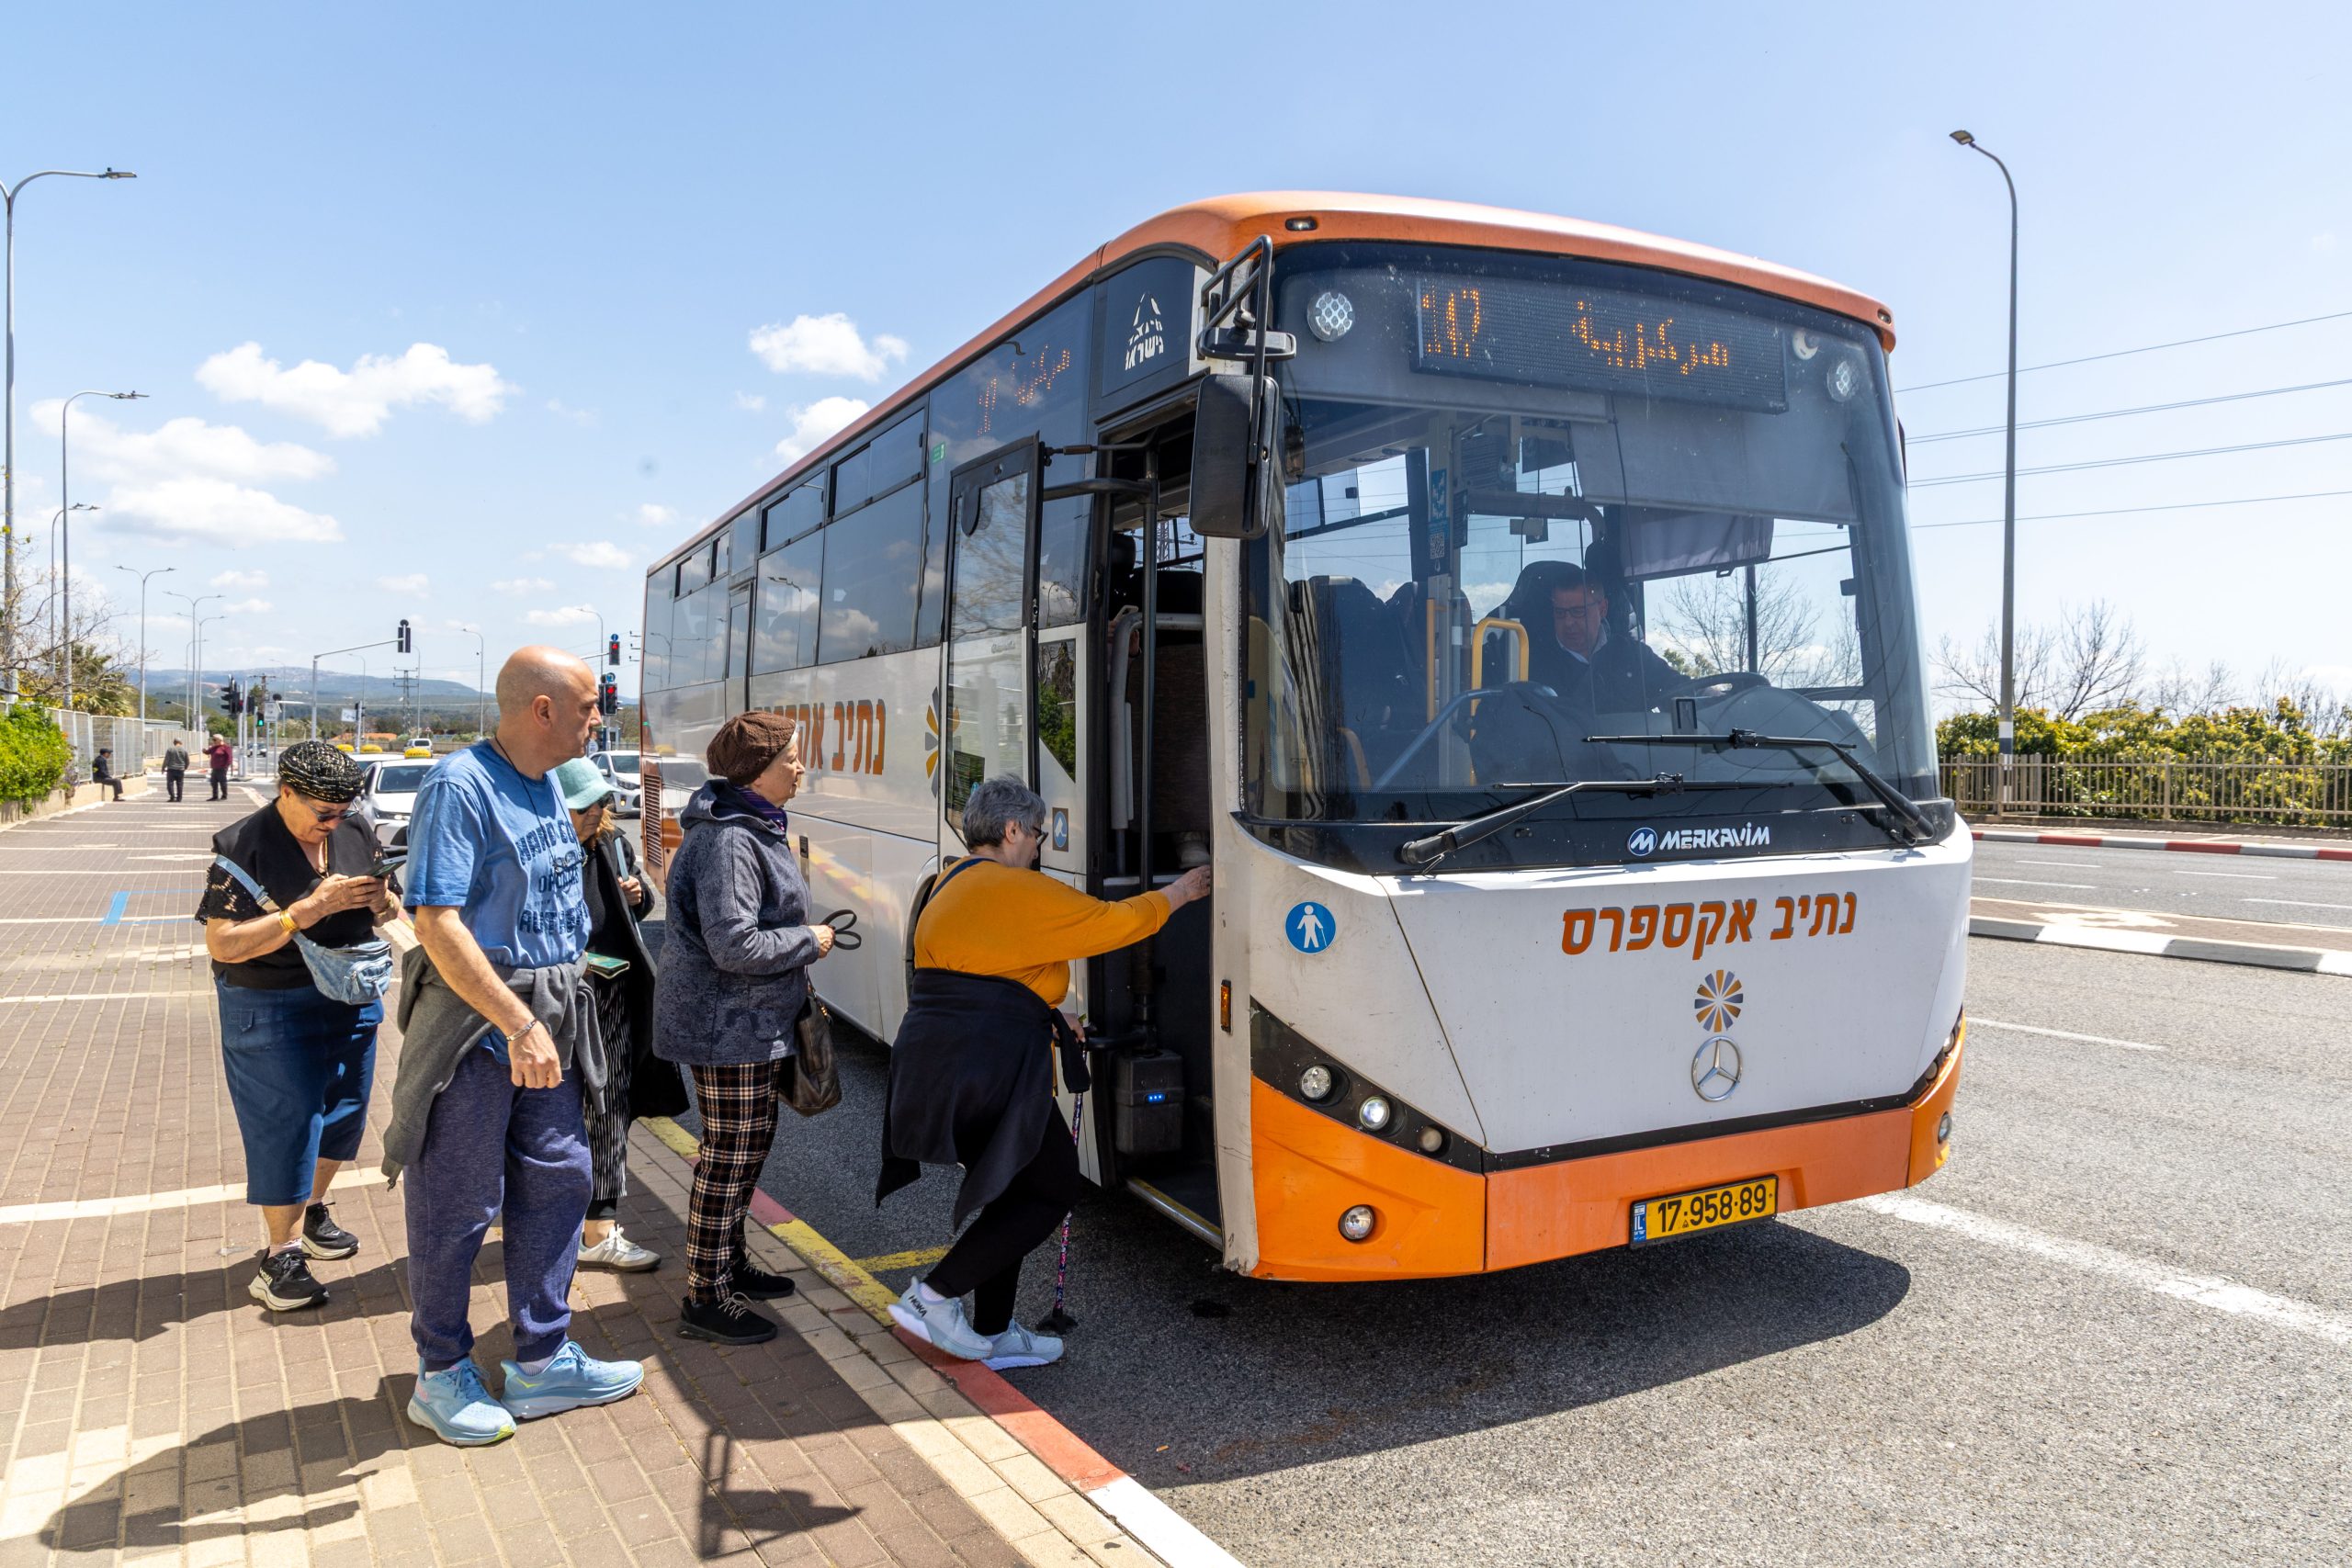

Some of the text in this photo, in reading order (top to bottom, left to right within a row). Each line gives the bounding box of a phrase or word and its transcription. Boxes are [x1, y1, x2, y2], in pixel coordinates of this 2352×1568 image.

[831, 698, 887, 776] נתיב
[1658, 821, 1770, 851] MERKAVIM
[1561, 891, 1858, 961] נתיב אקספרס
[1634, 1214, 1644, 1231] IL
[907, 1293, 928, 1318] HOKA
